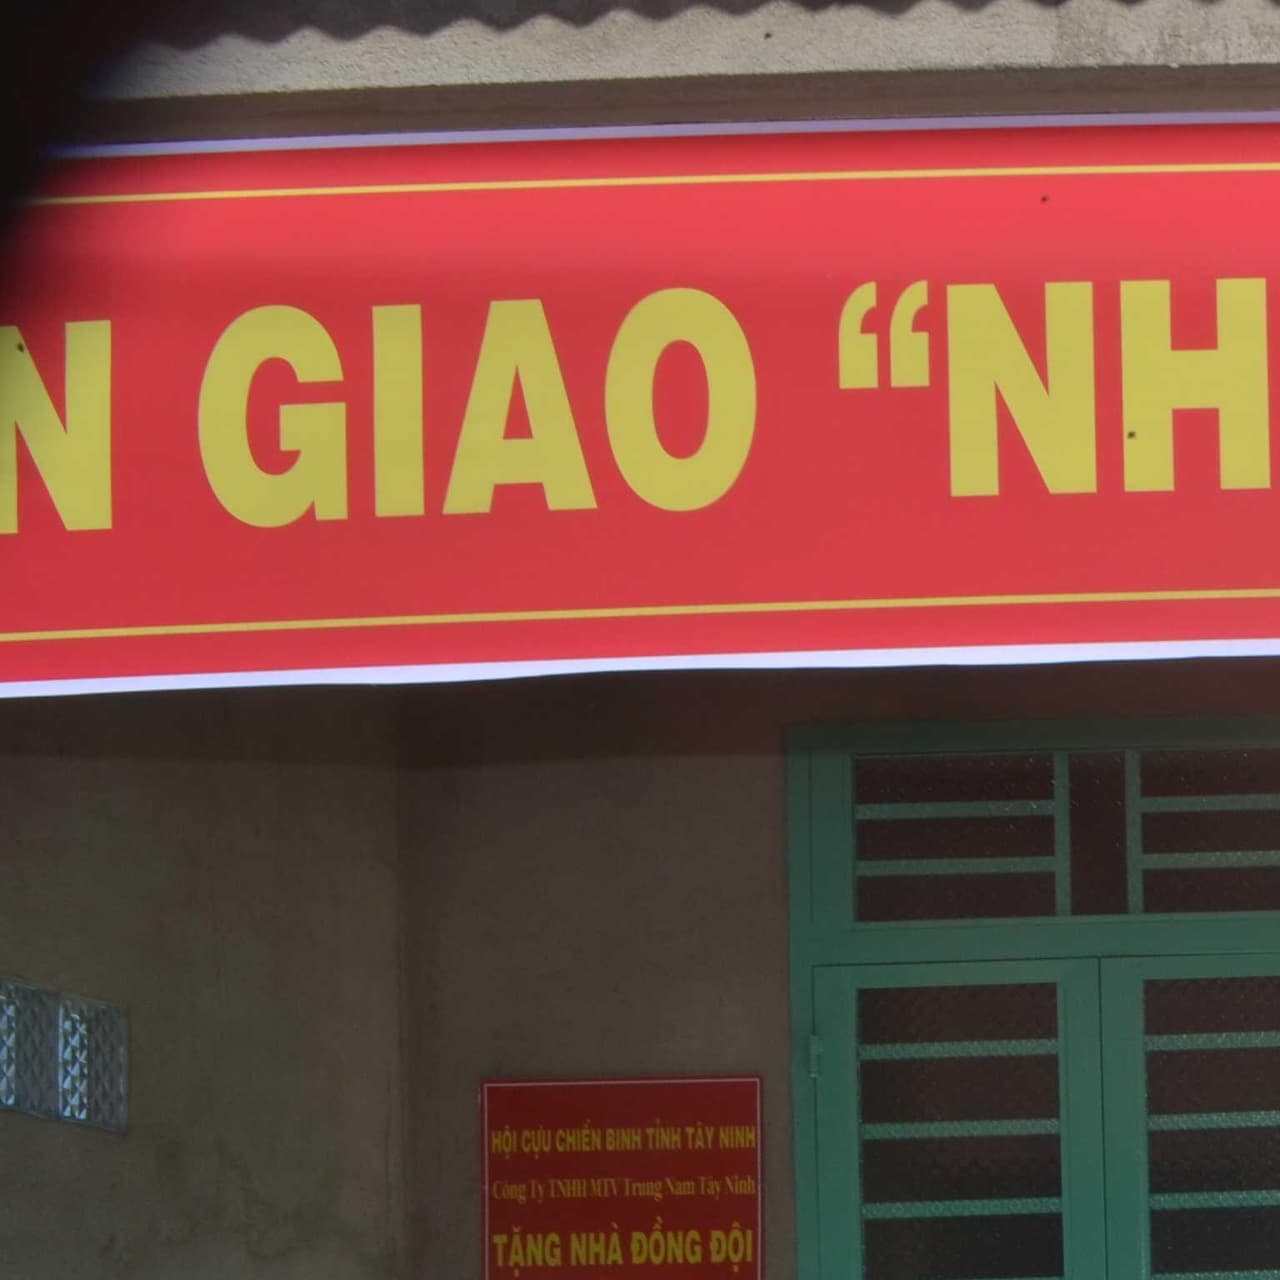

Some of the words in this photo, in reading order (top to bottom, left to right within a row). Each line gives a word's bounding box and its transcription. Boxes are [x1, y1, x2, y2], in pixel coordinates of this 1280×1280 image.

[198, 287, 757, 528] GIAO
[492, 1125, 518, 1159] HỘI
[556, 1119, 601, 1152] CHIẾN
[606, 1127, 641, 1150] BINH
[646, 1118, 681, 1149] TỈNH
[686, 1121, 715, 1149] TÂY
[719, 1126, 756, 1148] NINH
[530, 1180, 547, 1203] Ty
[549, 1179, 587, 1198] TNHH
[590, 1178, 618, 1198] MTV
[624, 1178, 663, 1201] Trung
[665, 1177, 696, 1196] Nam
[725, 1175, 756, 1195] Ninh
[493, 1226, 561, 1278] TẶNG
[570, 1222, 623, 1265] NHÀ
[630, 1215, 702, 1264] ĐỒNG
[710, 1221, 753, 1273] ĐỘI
